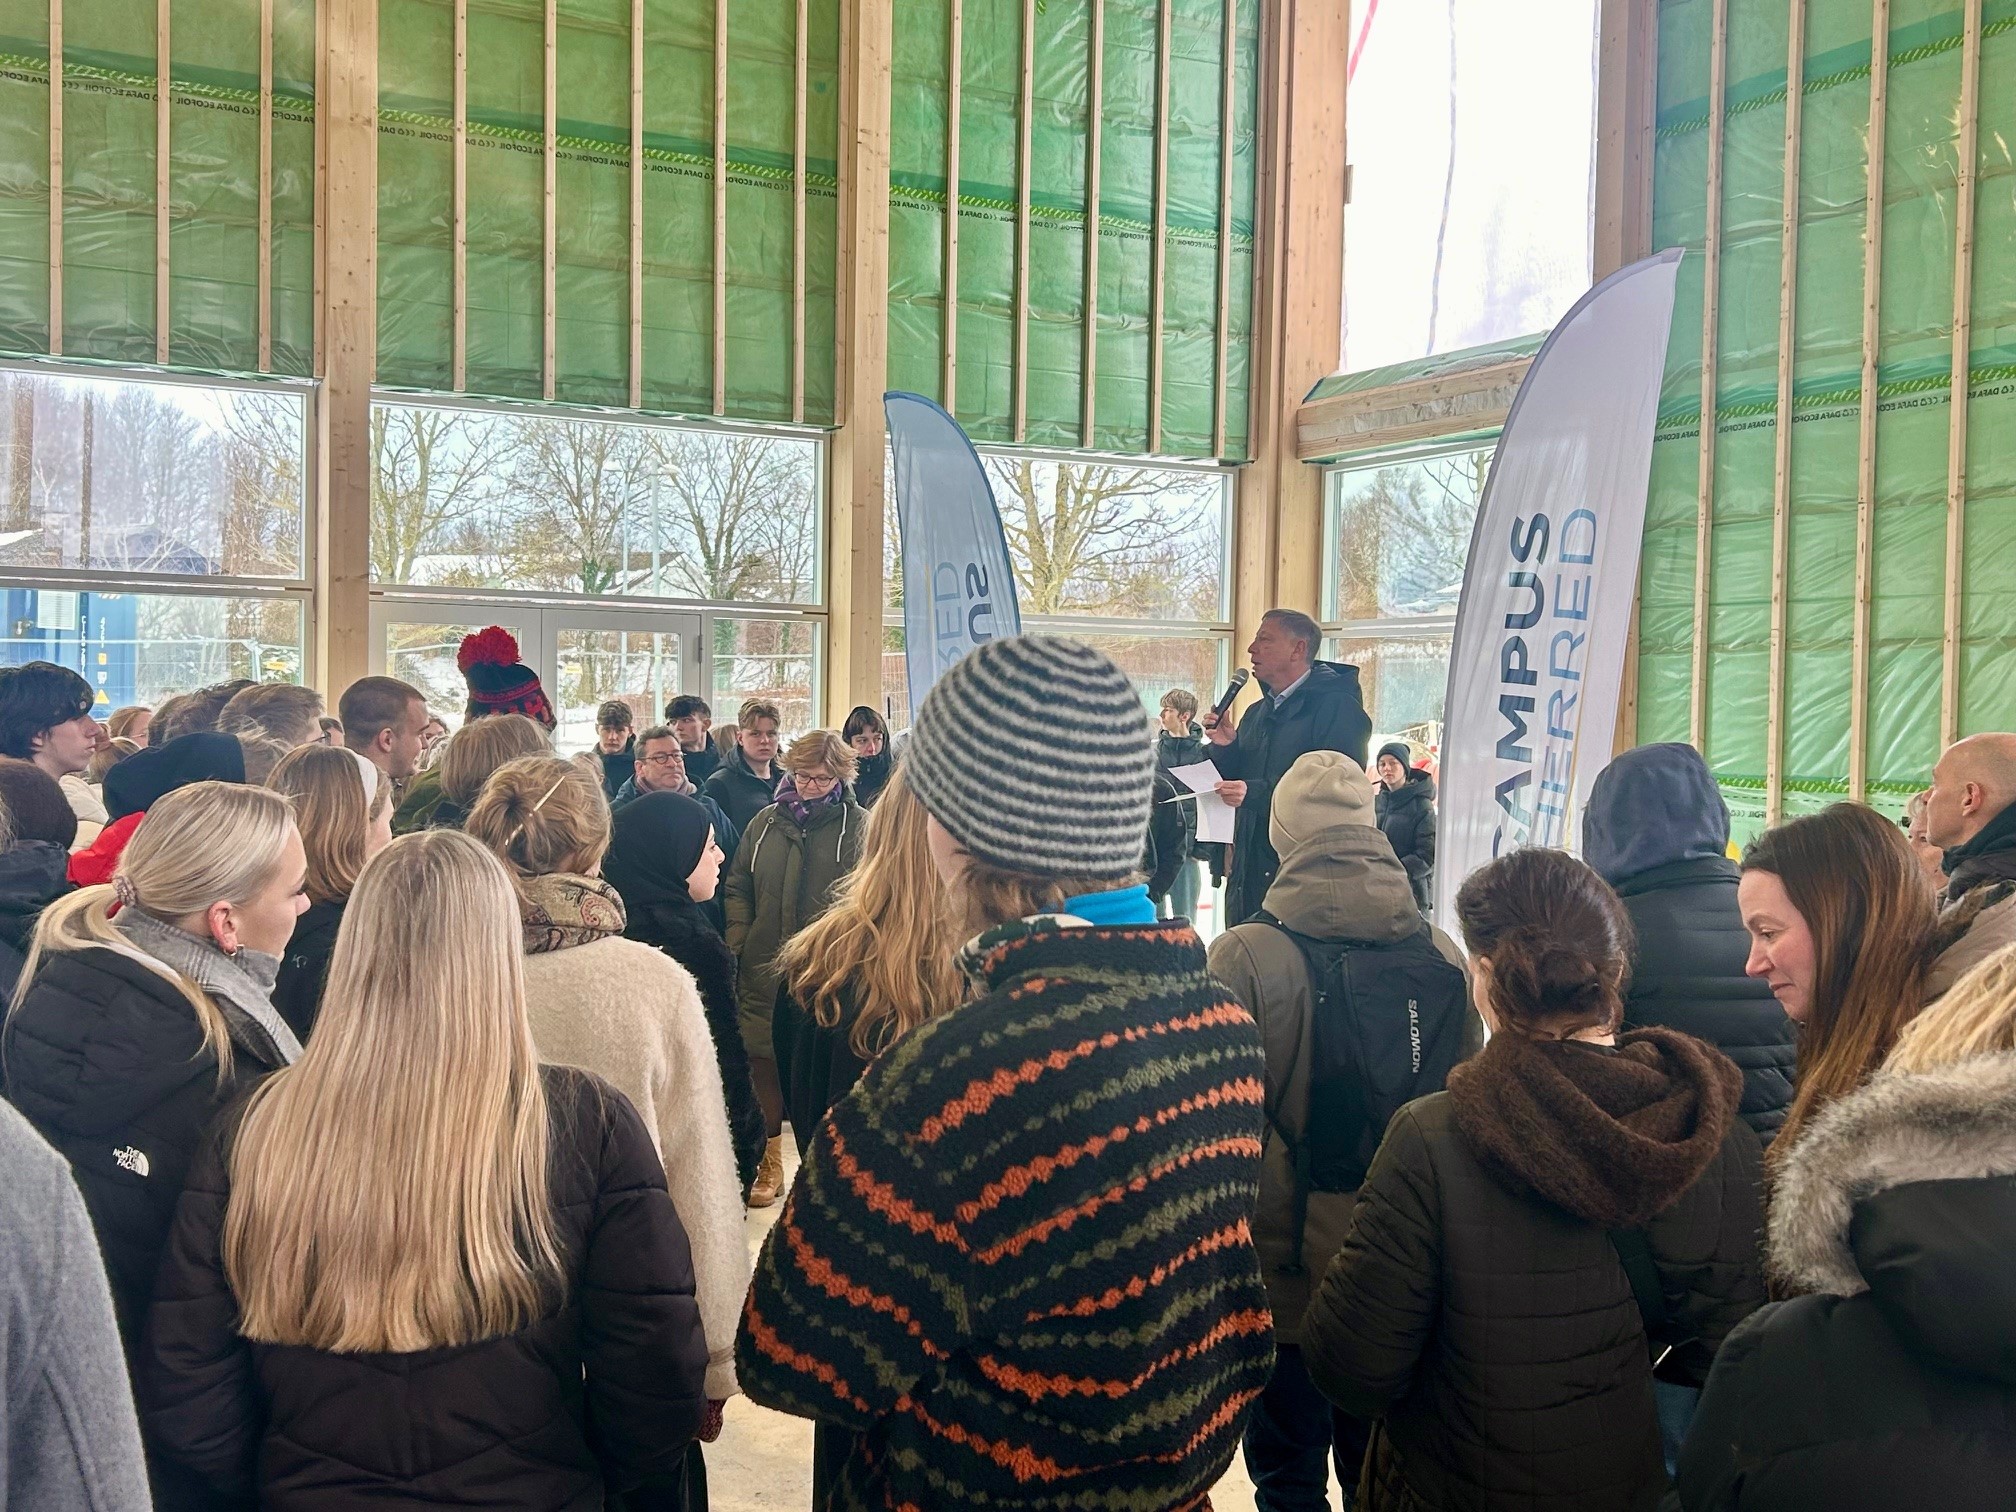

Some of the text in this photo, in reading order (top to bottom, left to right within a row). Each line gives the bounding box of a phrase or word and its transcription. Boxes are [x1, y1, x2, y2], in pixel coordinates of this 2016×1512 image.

[1408, 999, 1420, 1073] SALOMON
[112, 1147, 137, 1164] NORTH
[126, 1145, 141, 1158] THE
[116, 1158, 138, 1171] FACE
